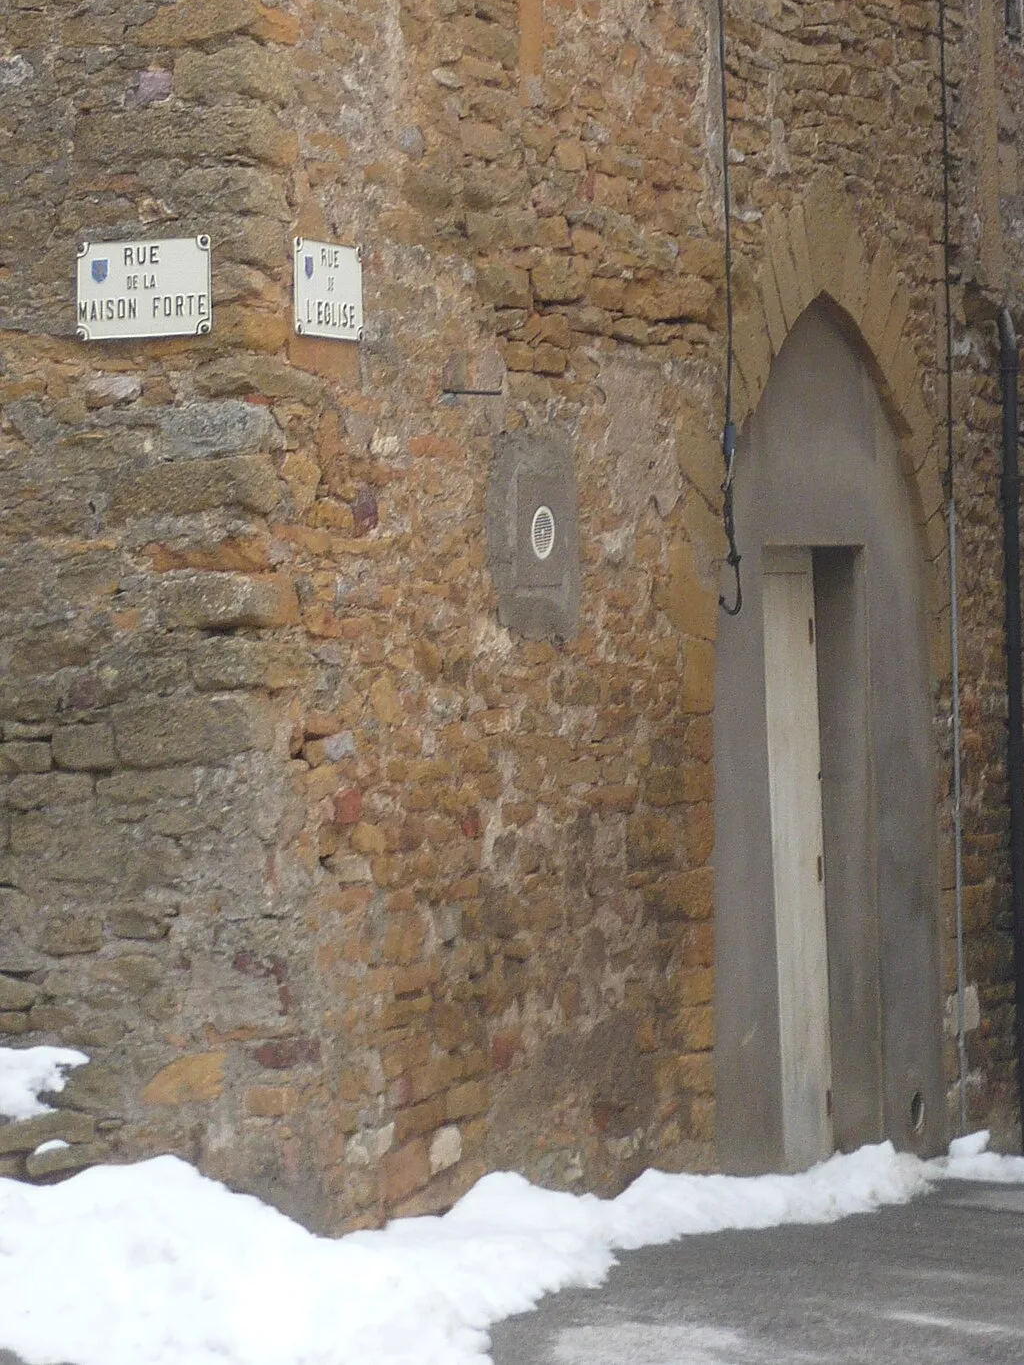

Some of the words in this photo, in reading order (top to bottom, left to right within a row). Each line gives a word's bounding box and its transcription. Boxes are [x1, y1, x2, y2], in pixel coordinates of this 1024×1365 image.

[124, 245, 159, 266] RUE
[321, 248, 339, 268] RUE
[127, 275, 138, 290] DE
[143, 274, 156, 289] LA
[79, 298, 137, 322] MAISON
[152, 294, 206, 318] FORTE
